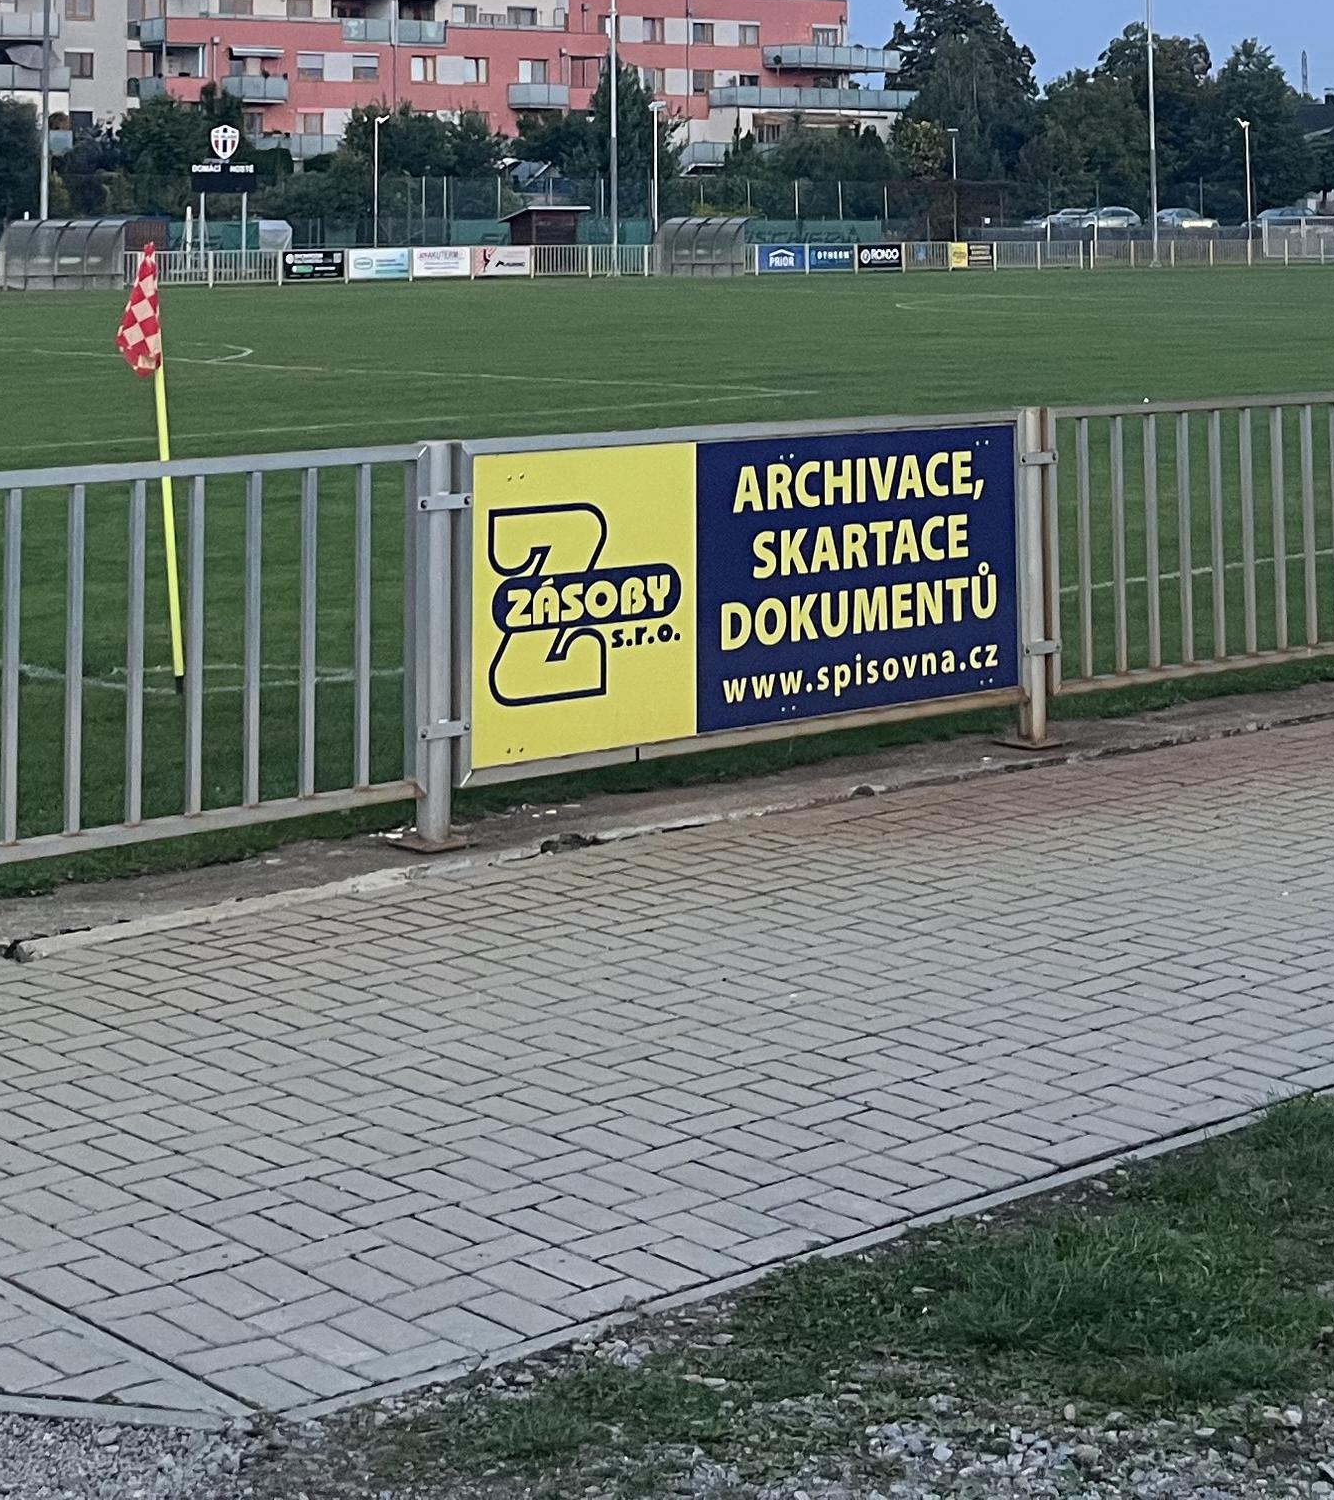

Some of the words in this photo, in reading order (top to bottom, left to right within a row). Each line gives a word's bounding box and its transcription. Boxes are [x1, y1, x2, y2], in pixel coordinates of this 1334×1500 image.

[769, 256, 795, 267] PRIOR
[870, 248, 900, 260] RONDO
[732, 449, 985, 514] ARCHIVACE,
[752, 514, 970, 580] SKARTACE
[505, 573, 673, 628] ZÁSOBY
[720, 561, 999, 651] DOKUMENTŮ
[610, 621, 681, 649] s.r.o.
[722, 642, 1000, 705] www.spisovna.cz
